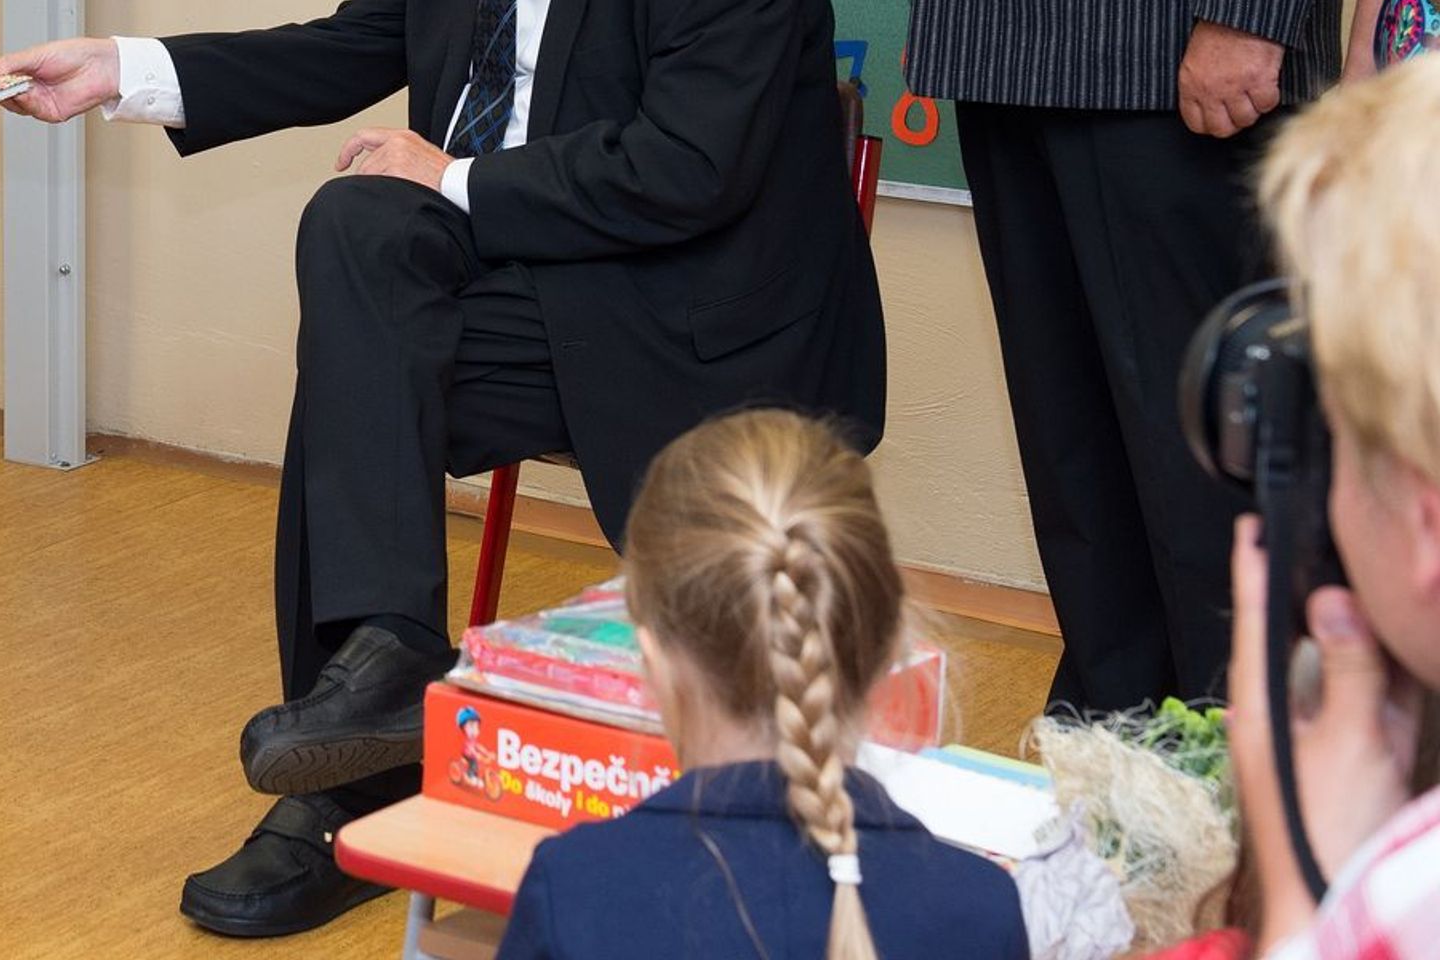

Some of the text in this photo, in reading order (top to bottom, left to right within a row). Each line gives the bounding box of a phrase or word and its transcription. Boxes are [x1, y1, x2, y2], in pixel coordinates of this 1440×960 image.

[499, 770, 523, 795] Do
[524, 781, 572, 818] školy
[586, 795, 609, 818] do
